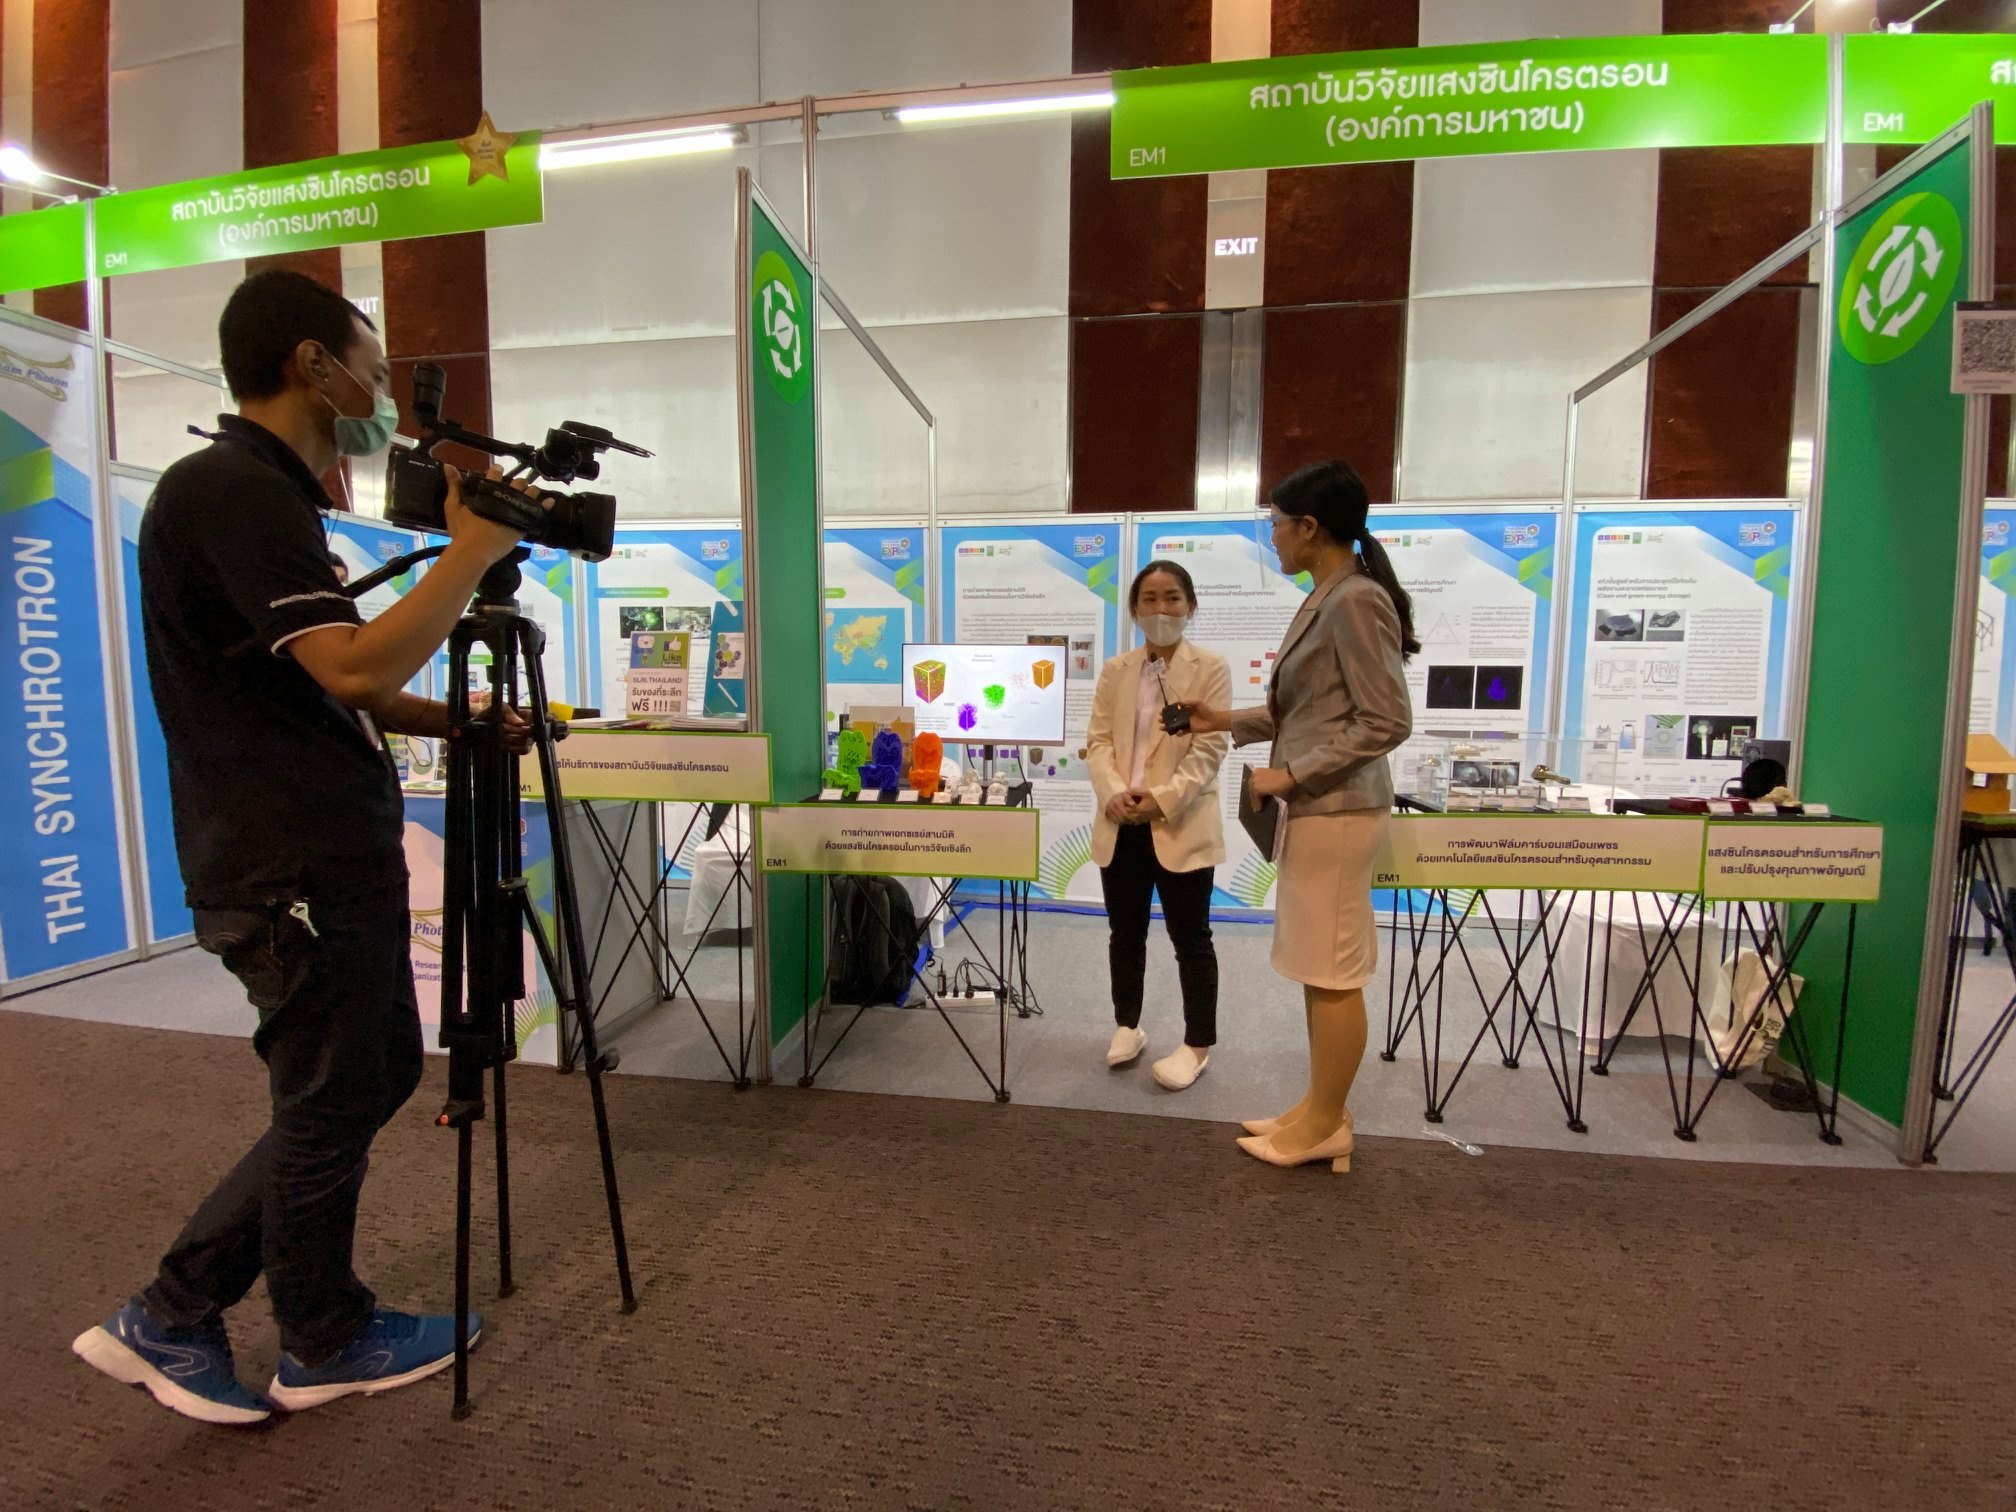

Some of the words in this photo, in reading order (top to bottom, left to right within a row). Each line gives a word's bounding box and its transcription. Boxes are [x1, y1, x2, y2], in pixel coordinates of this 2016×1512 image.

[1250, 58, 1669, 109] สถาบันวิจัยแสงซินโครตรอน
[1326, 101, 1584, 148] (องค์การมหาชน)
[1863, 112, 1904, 132] EM1
[1129, 147, 1167, 168] EM1
[171, 165, 430, 222] สถาบันวิจัยแสงซินโครตรอน
[219, 202, 378, 247] (องค์การมหาชน)
[1214, 237, 1258, 256] EXIT
[105, 253, 128, 269] EM1
[12, 536, 76, 836] SYNCHROTRON
[632, 698, 649, 712] ฟรี
[1708, 845, 1881, 860] แสงซินโครตรอนสำหรับการศึกษา
[766, 858, 788, 868] EM1
[1720, 863, 1866, 878] และปรับปรุงคุณภาพอัญมณี
[1377, 873, 1400, 883] EM1
[40, 854, 87, 945] THAI
[414, 921, 443, 936] Phot
